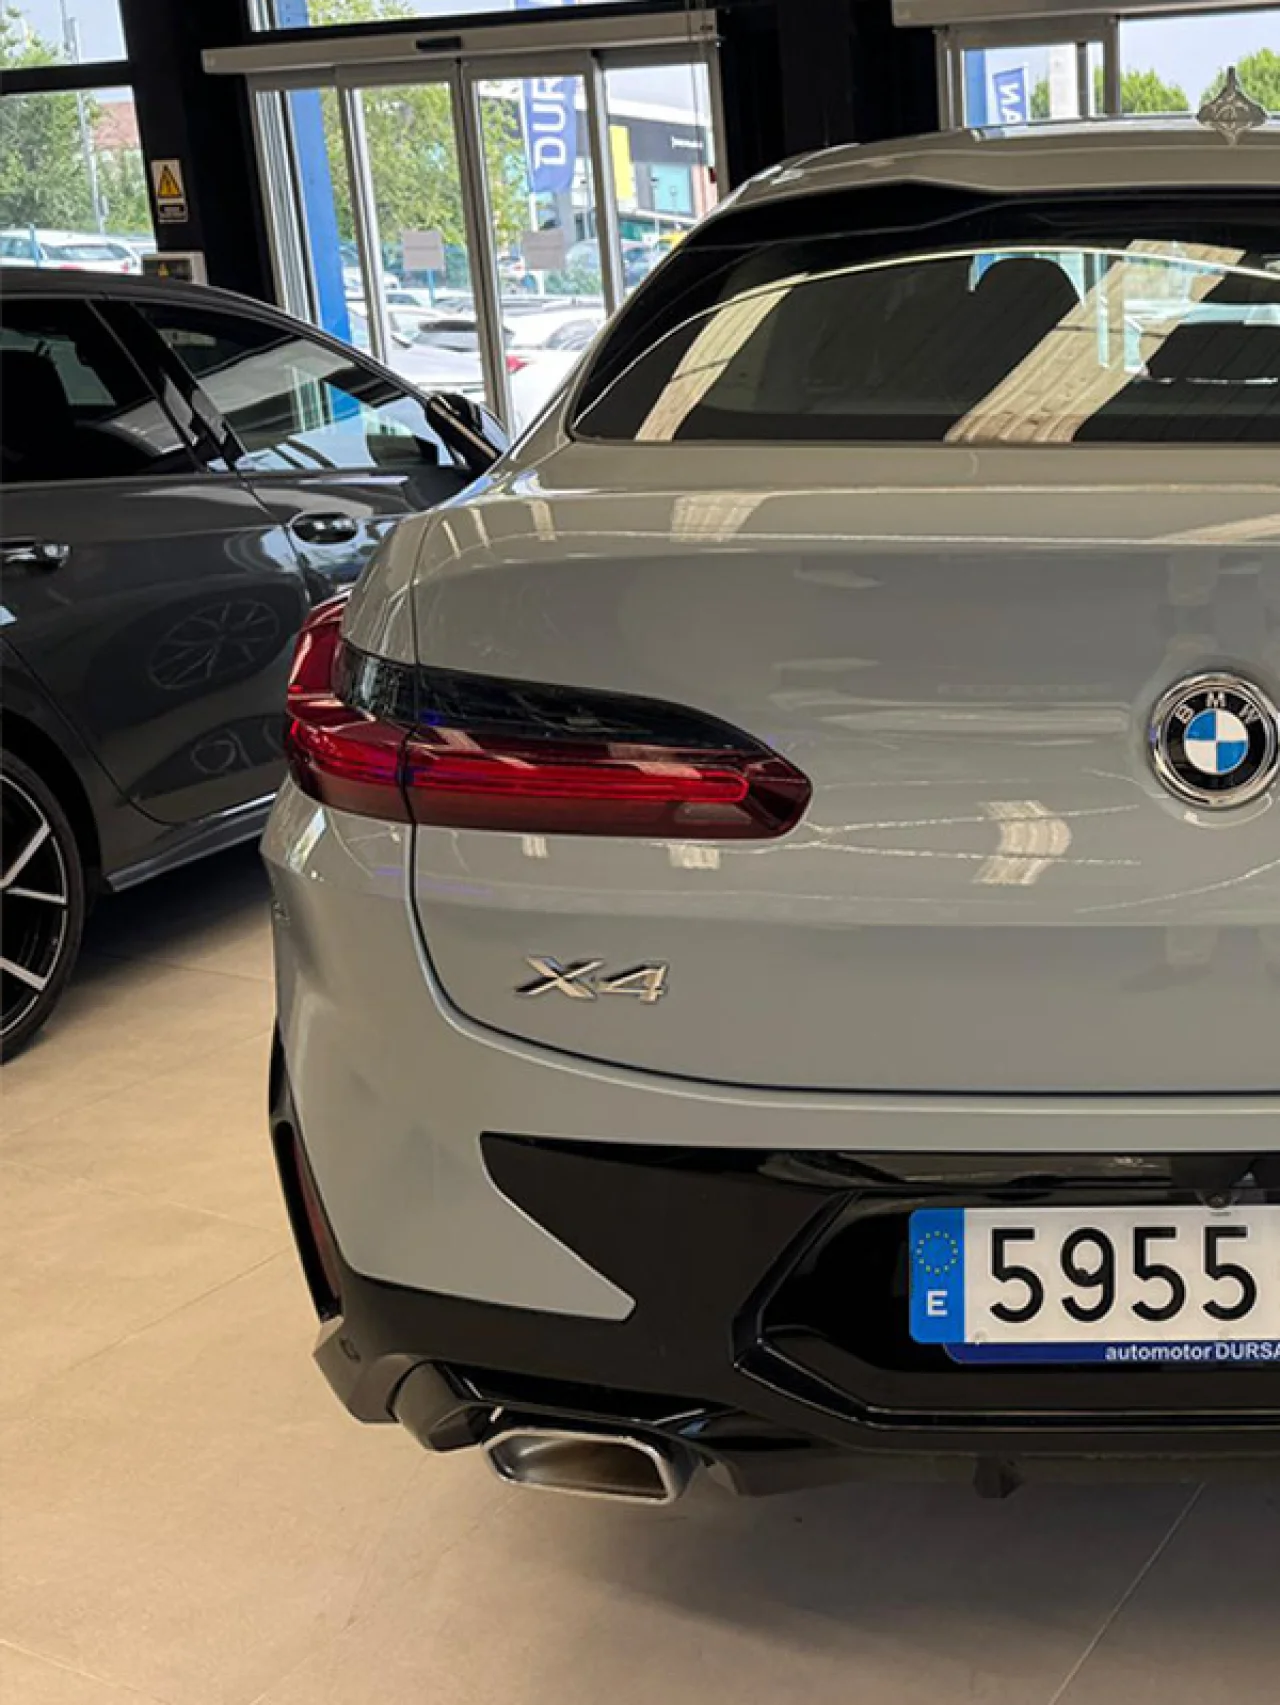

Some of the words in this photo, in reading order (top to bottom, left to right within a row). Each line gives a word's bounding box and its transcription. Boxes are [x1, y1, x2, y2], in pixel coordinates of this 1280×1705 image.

[1172, 691, 1262, 725] BMW
[514, 955, 667, 1003] X4
[926, 1290, 948, 1316] E
[988, 1226, 1258, 1324] 5955
